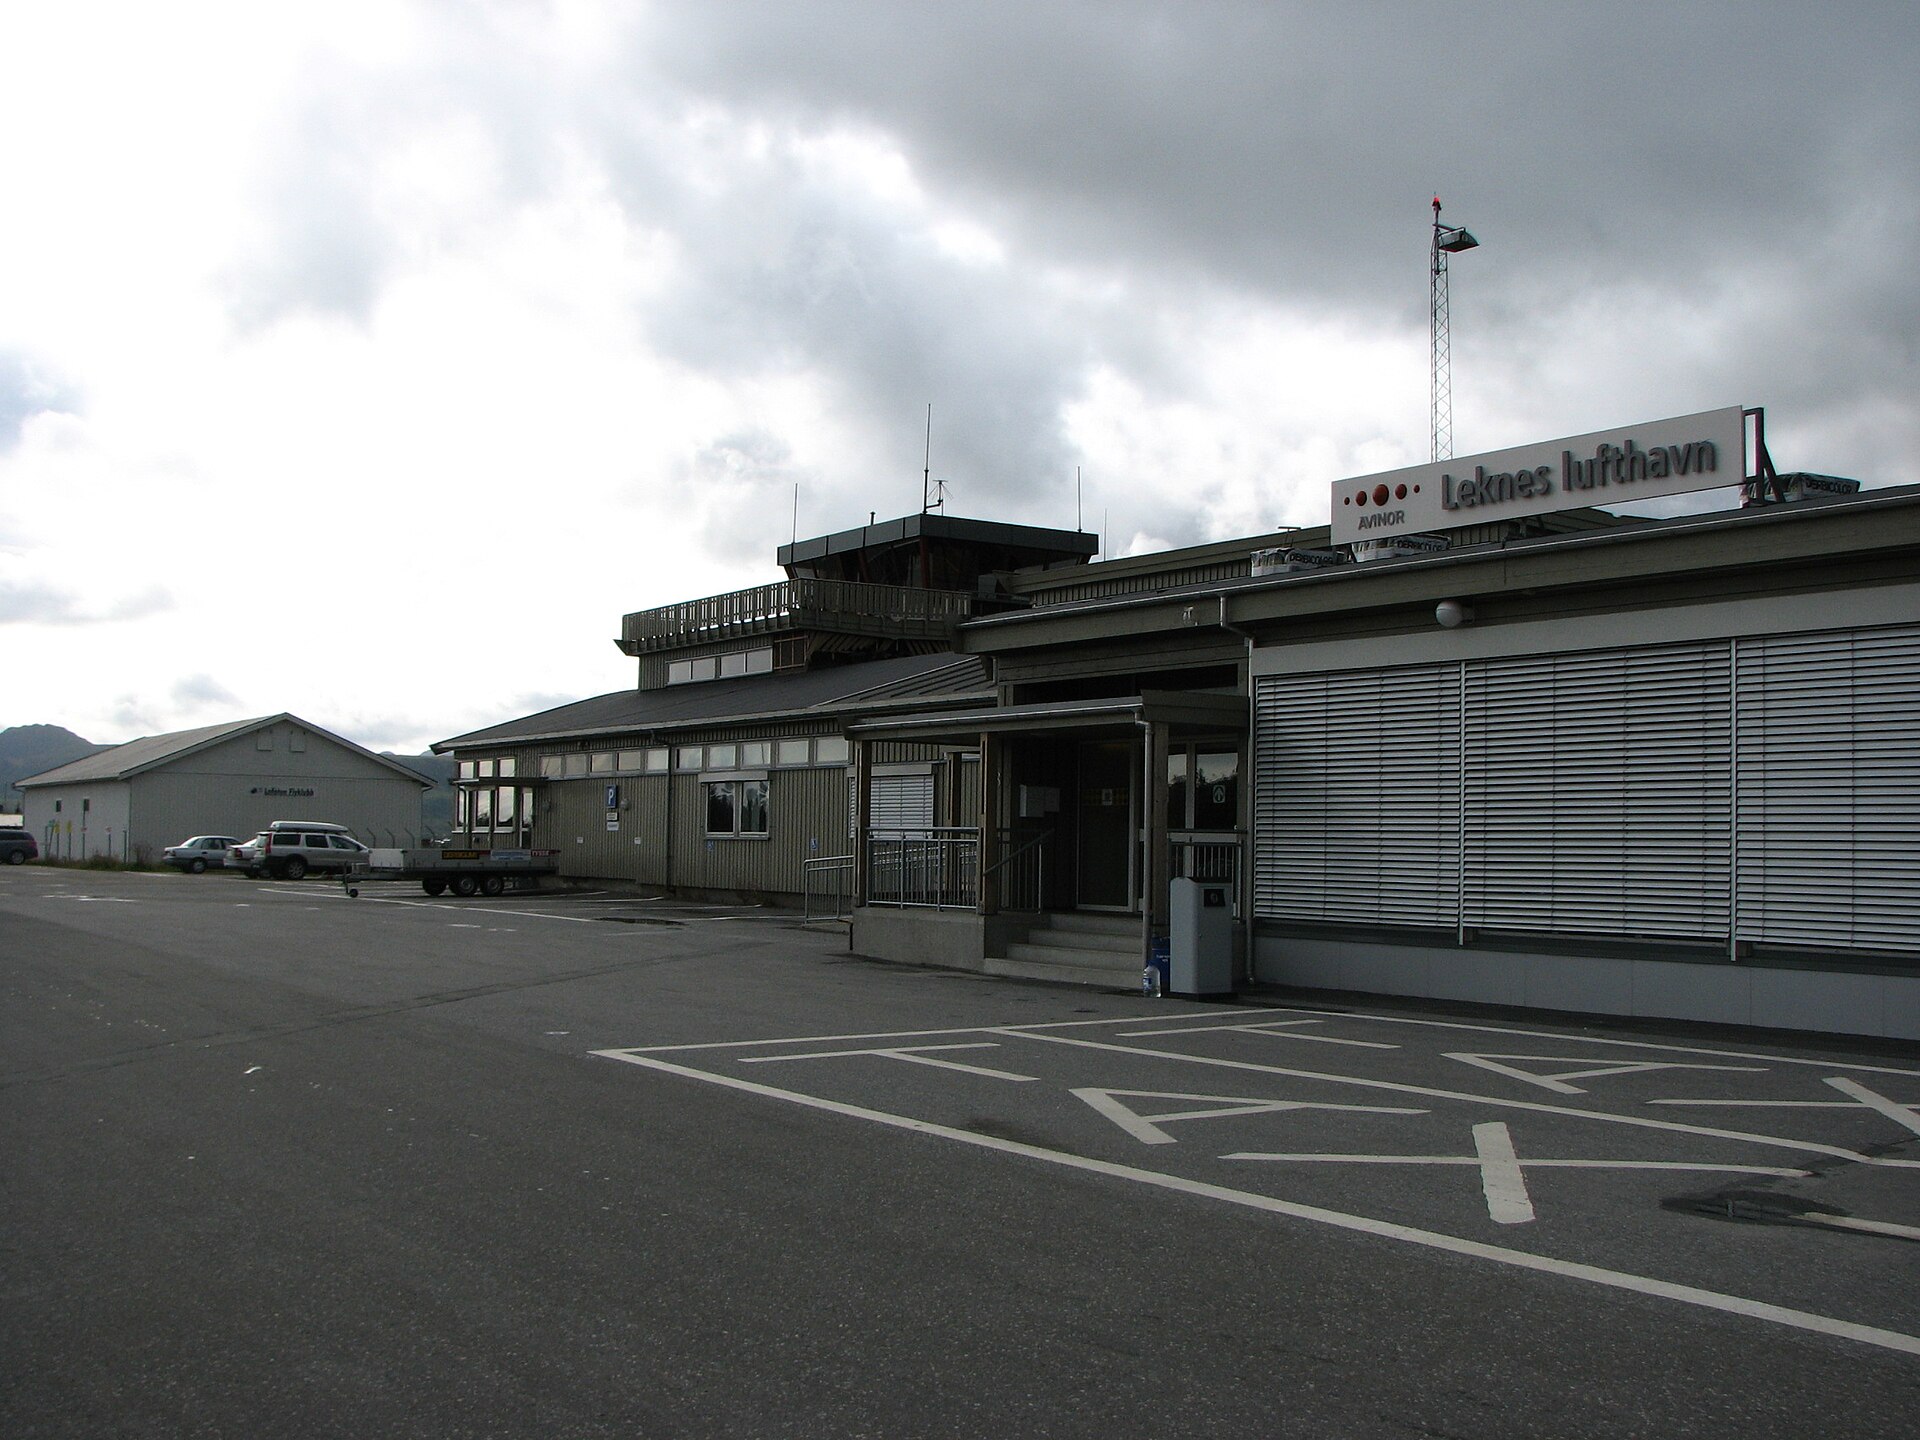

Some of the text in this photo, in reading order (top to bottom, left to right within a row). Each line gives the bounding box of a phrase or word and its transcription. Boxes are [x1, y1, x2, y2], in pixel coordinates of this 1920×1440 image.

[1441, 439, 1717, 510] Leknes lufthavn
[1358, 510, 1405, 531] AVINOR
